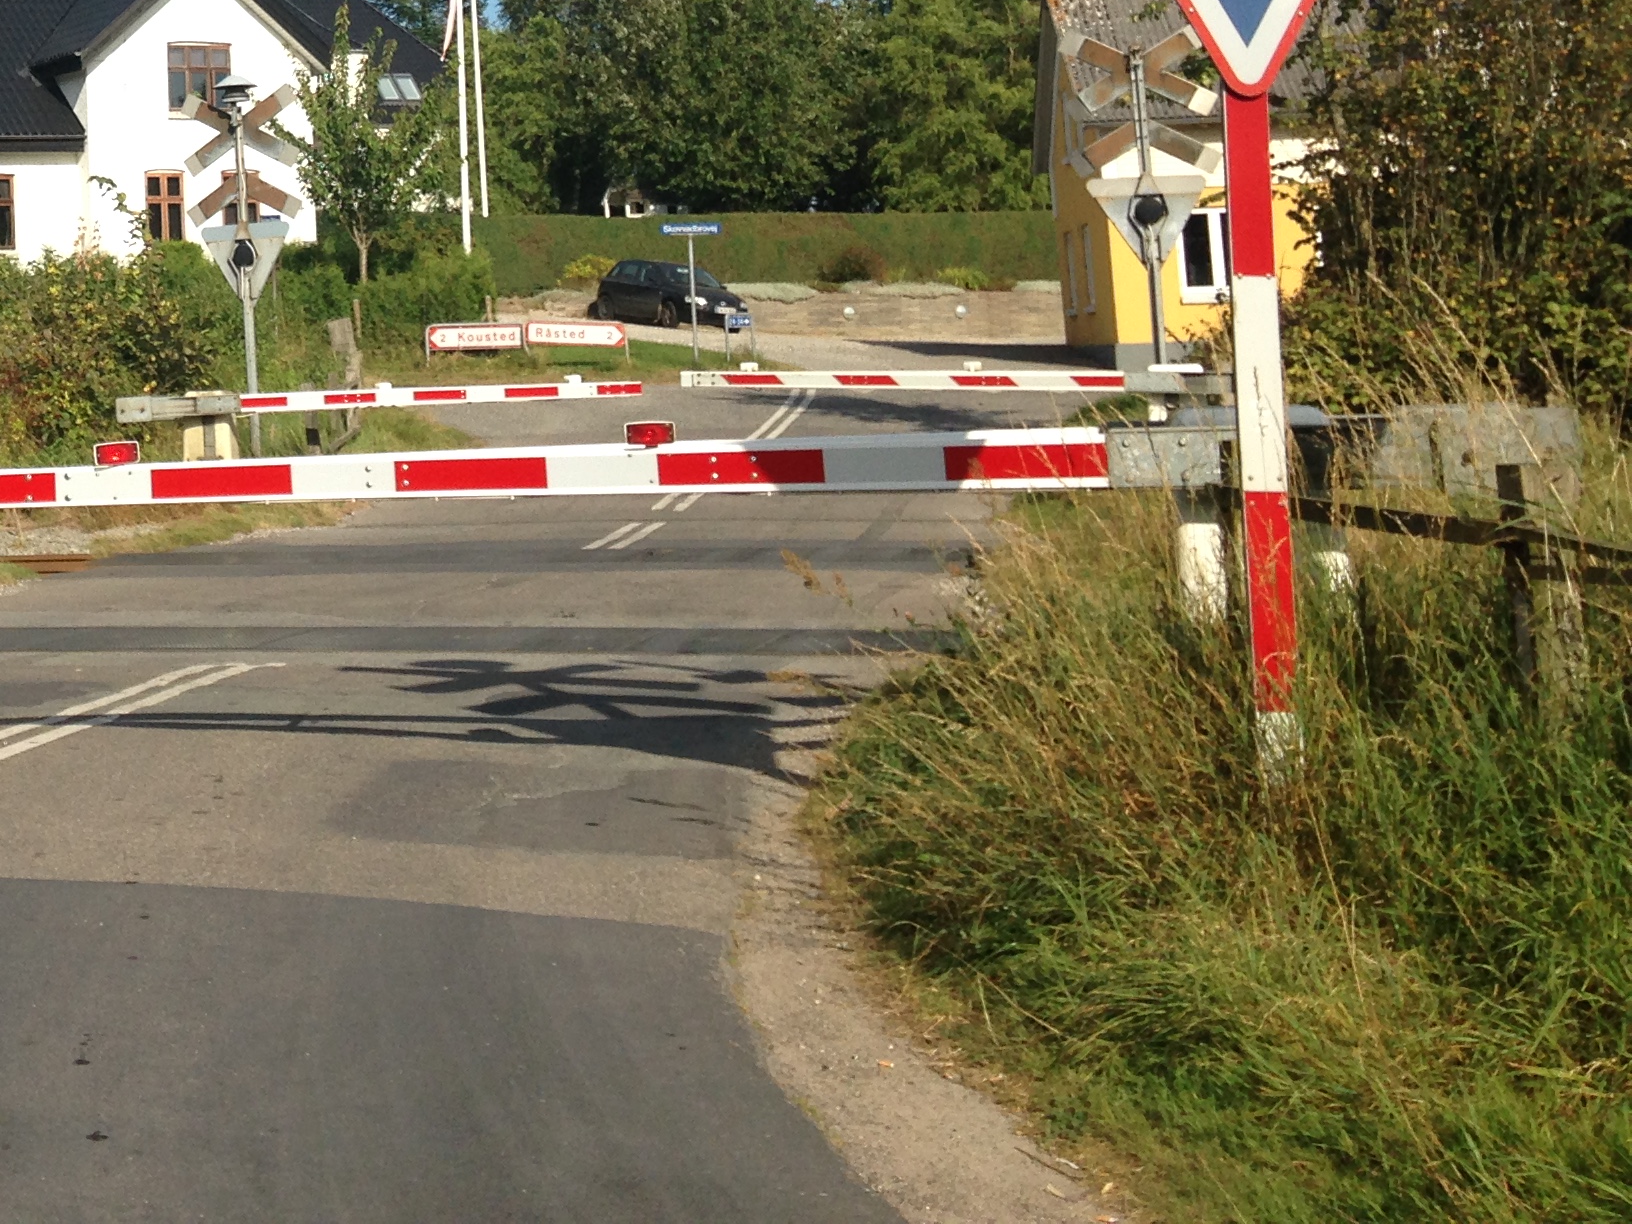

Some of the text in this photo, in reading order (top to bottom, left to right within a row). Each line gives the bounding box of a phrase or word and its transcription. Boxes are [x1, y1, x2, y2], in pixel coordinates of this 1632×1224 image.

[440, 331, 516, 343] 2 Kousted
[535, 327, 613, 340] Råsted 2
